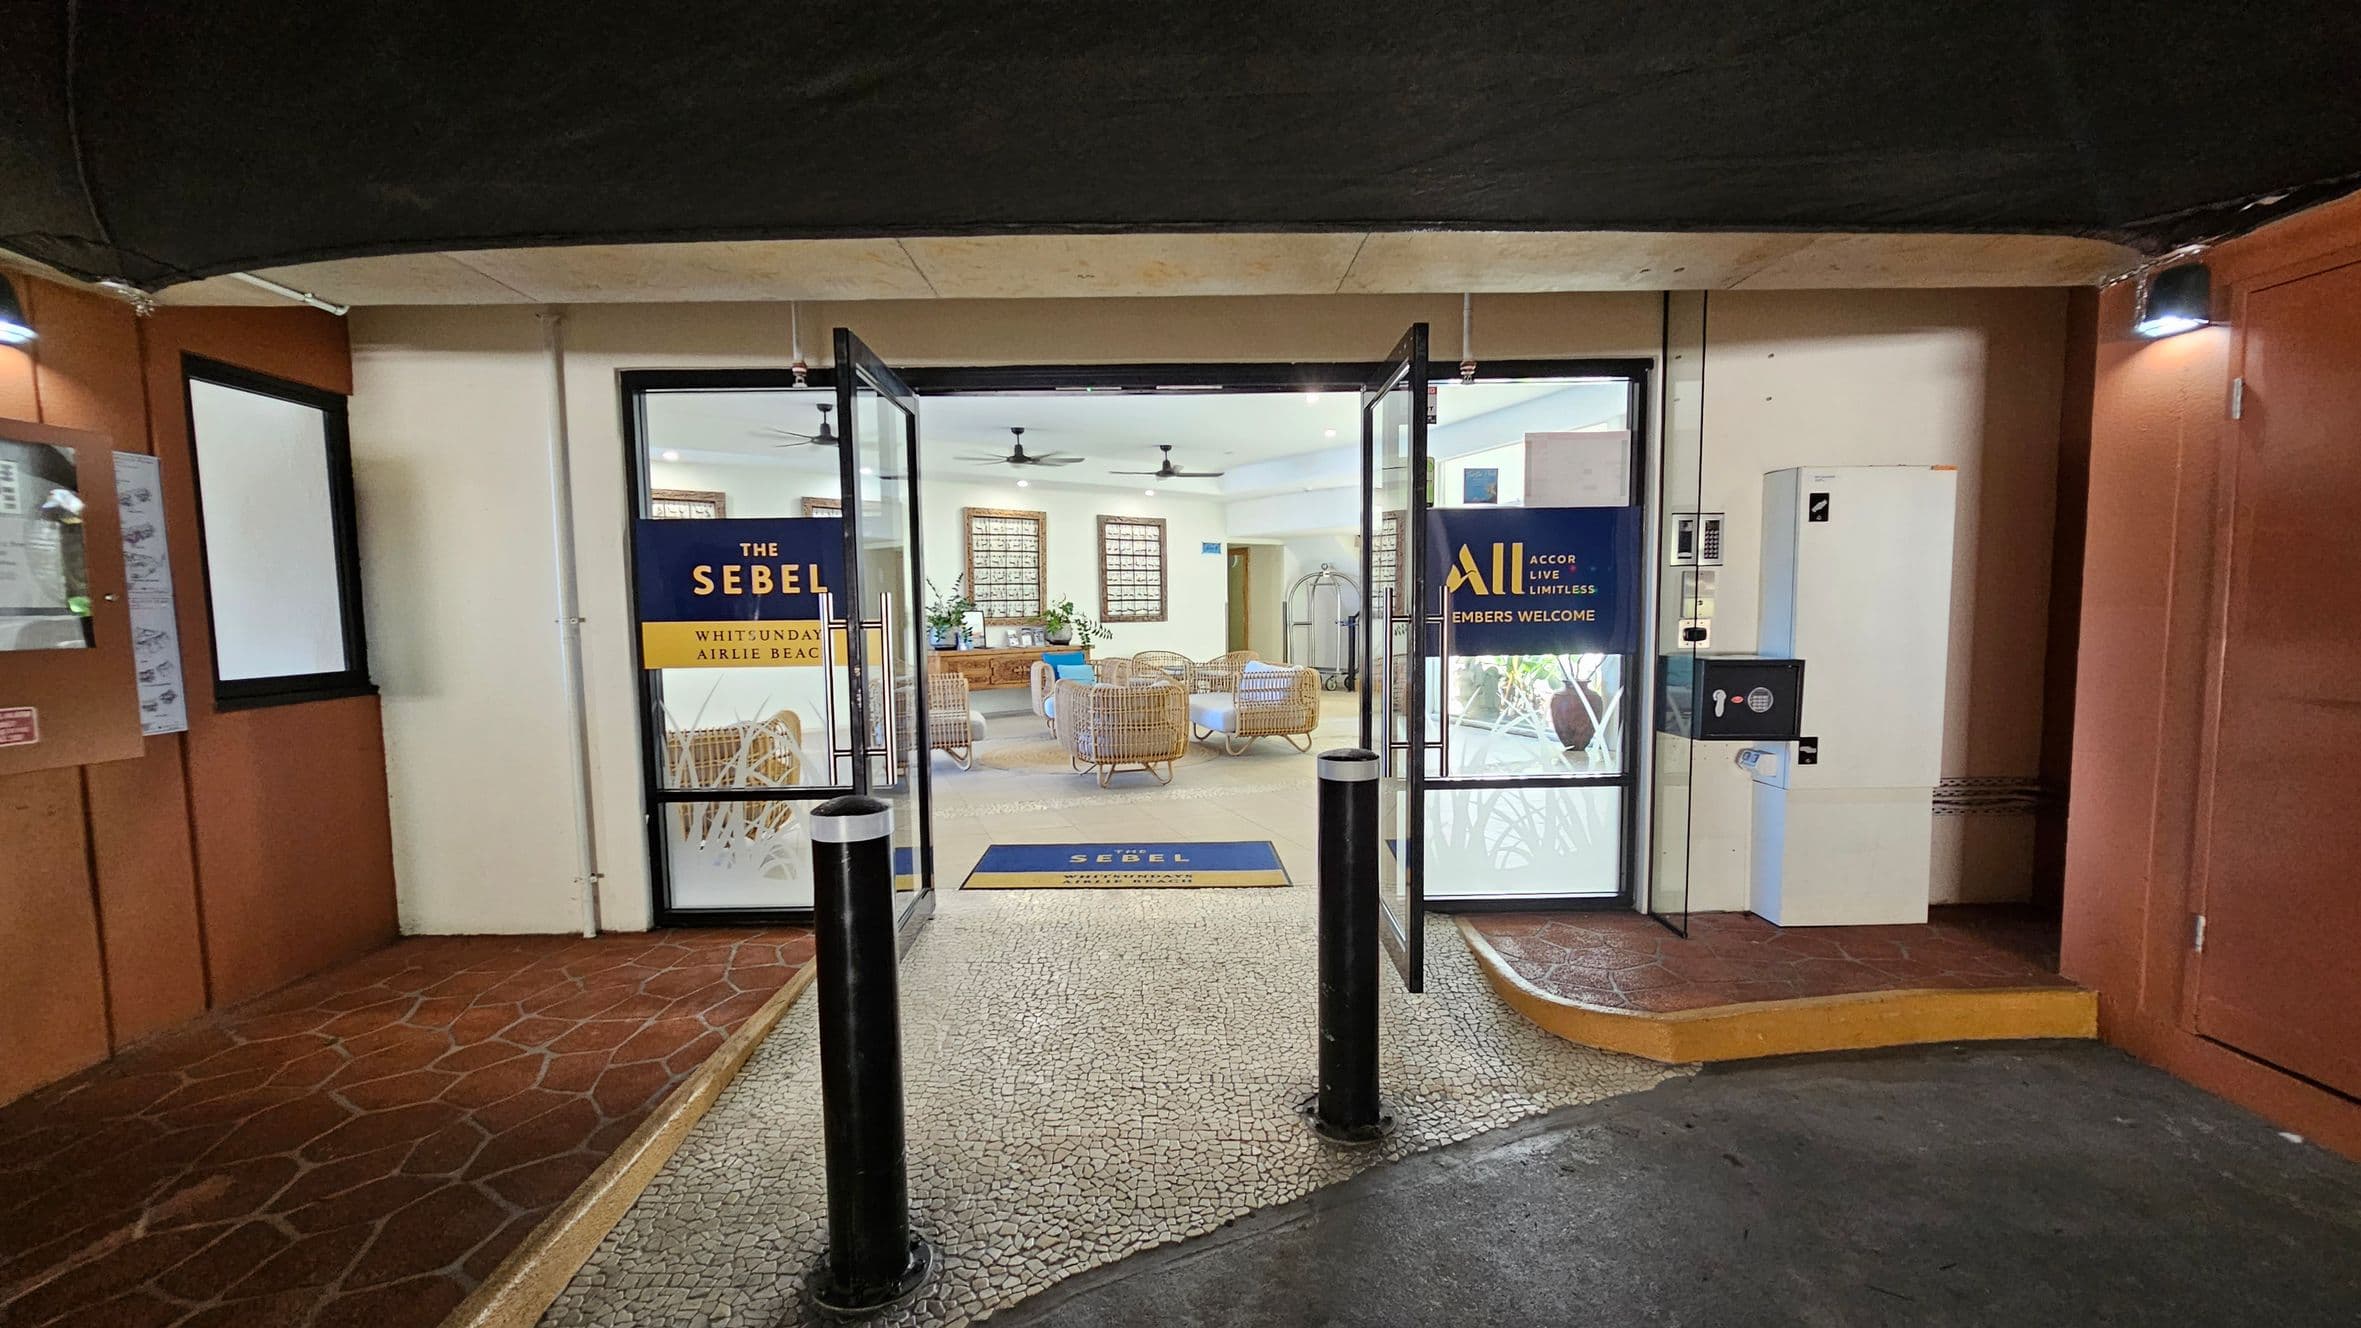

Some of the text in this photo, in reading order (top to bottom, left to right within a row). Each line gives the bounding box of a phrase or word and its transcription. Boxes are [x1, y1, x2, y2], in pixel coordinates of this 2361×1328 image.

[740, 543, 778, 557] THE
[1530, 554, 1576, 565] ACCOR
[693, 564, 828, 596] SEBEL
[1530, 570, 1560, 580] LIVE
[1530, 584, 1596, 595] LIMITLESS
[1452, 609, 1596, 623] EMBERS WELCOME
[695, 629, 822, 642] WHITSUNDAY
[697, 647, 820, 660] AIRLIE BEAC
[1069, 853, 1190, 863] SEBEL
